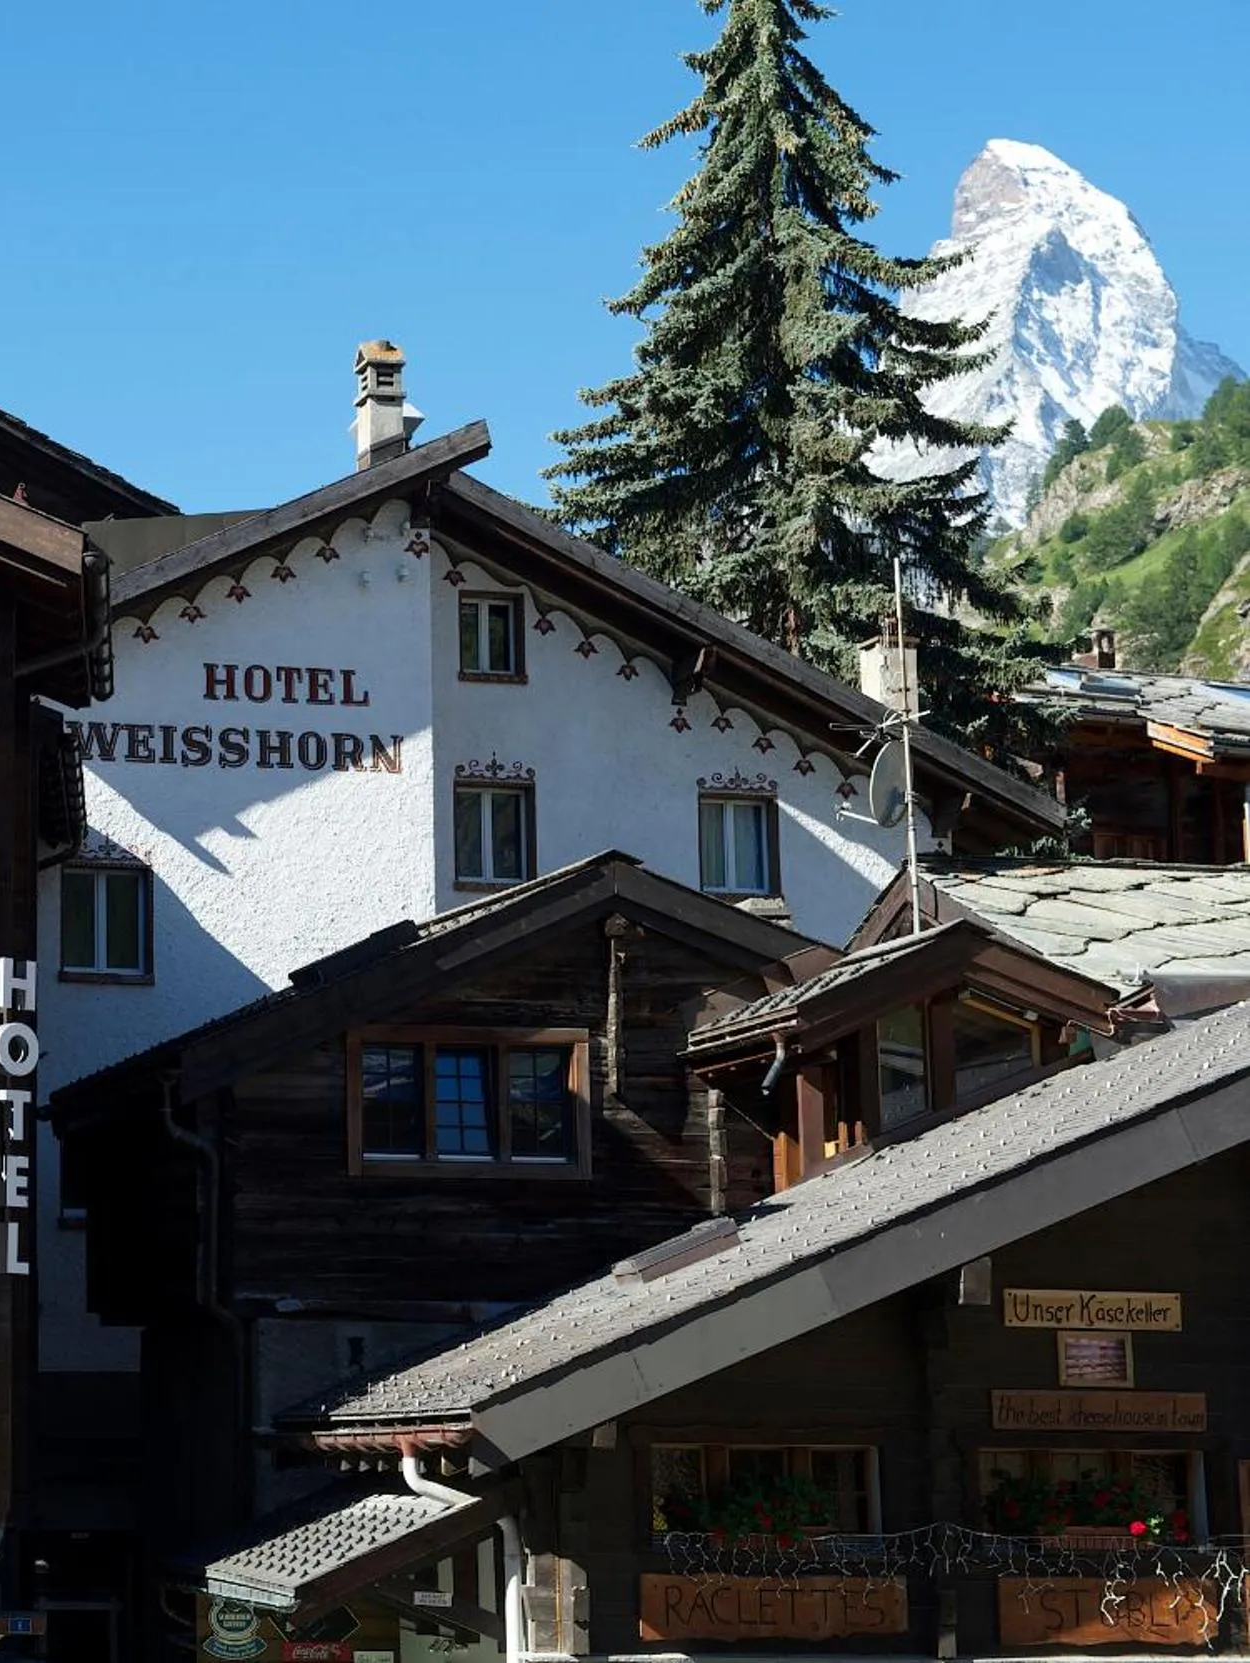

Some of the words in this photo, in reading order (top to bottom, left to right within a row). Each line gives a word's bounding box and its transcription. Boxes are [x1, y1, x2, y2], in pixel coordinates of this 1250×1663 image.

[202, 662, 370, 707] HOTEL
[64, 721, 404, 774] WEISSHORN
[1012, 1293, 1074, 1323] Unser
[1079, 1293, 1171, 1326] Käsekeller
[1027, 1398, 1062, 1425] best
[664, 1584, 886, 1627] RACLETTES
